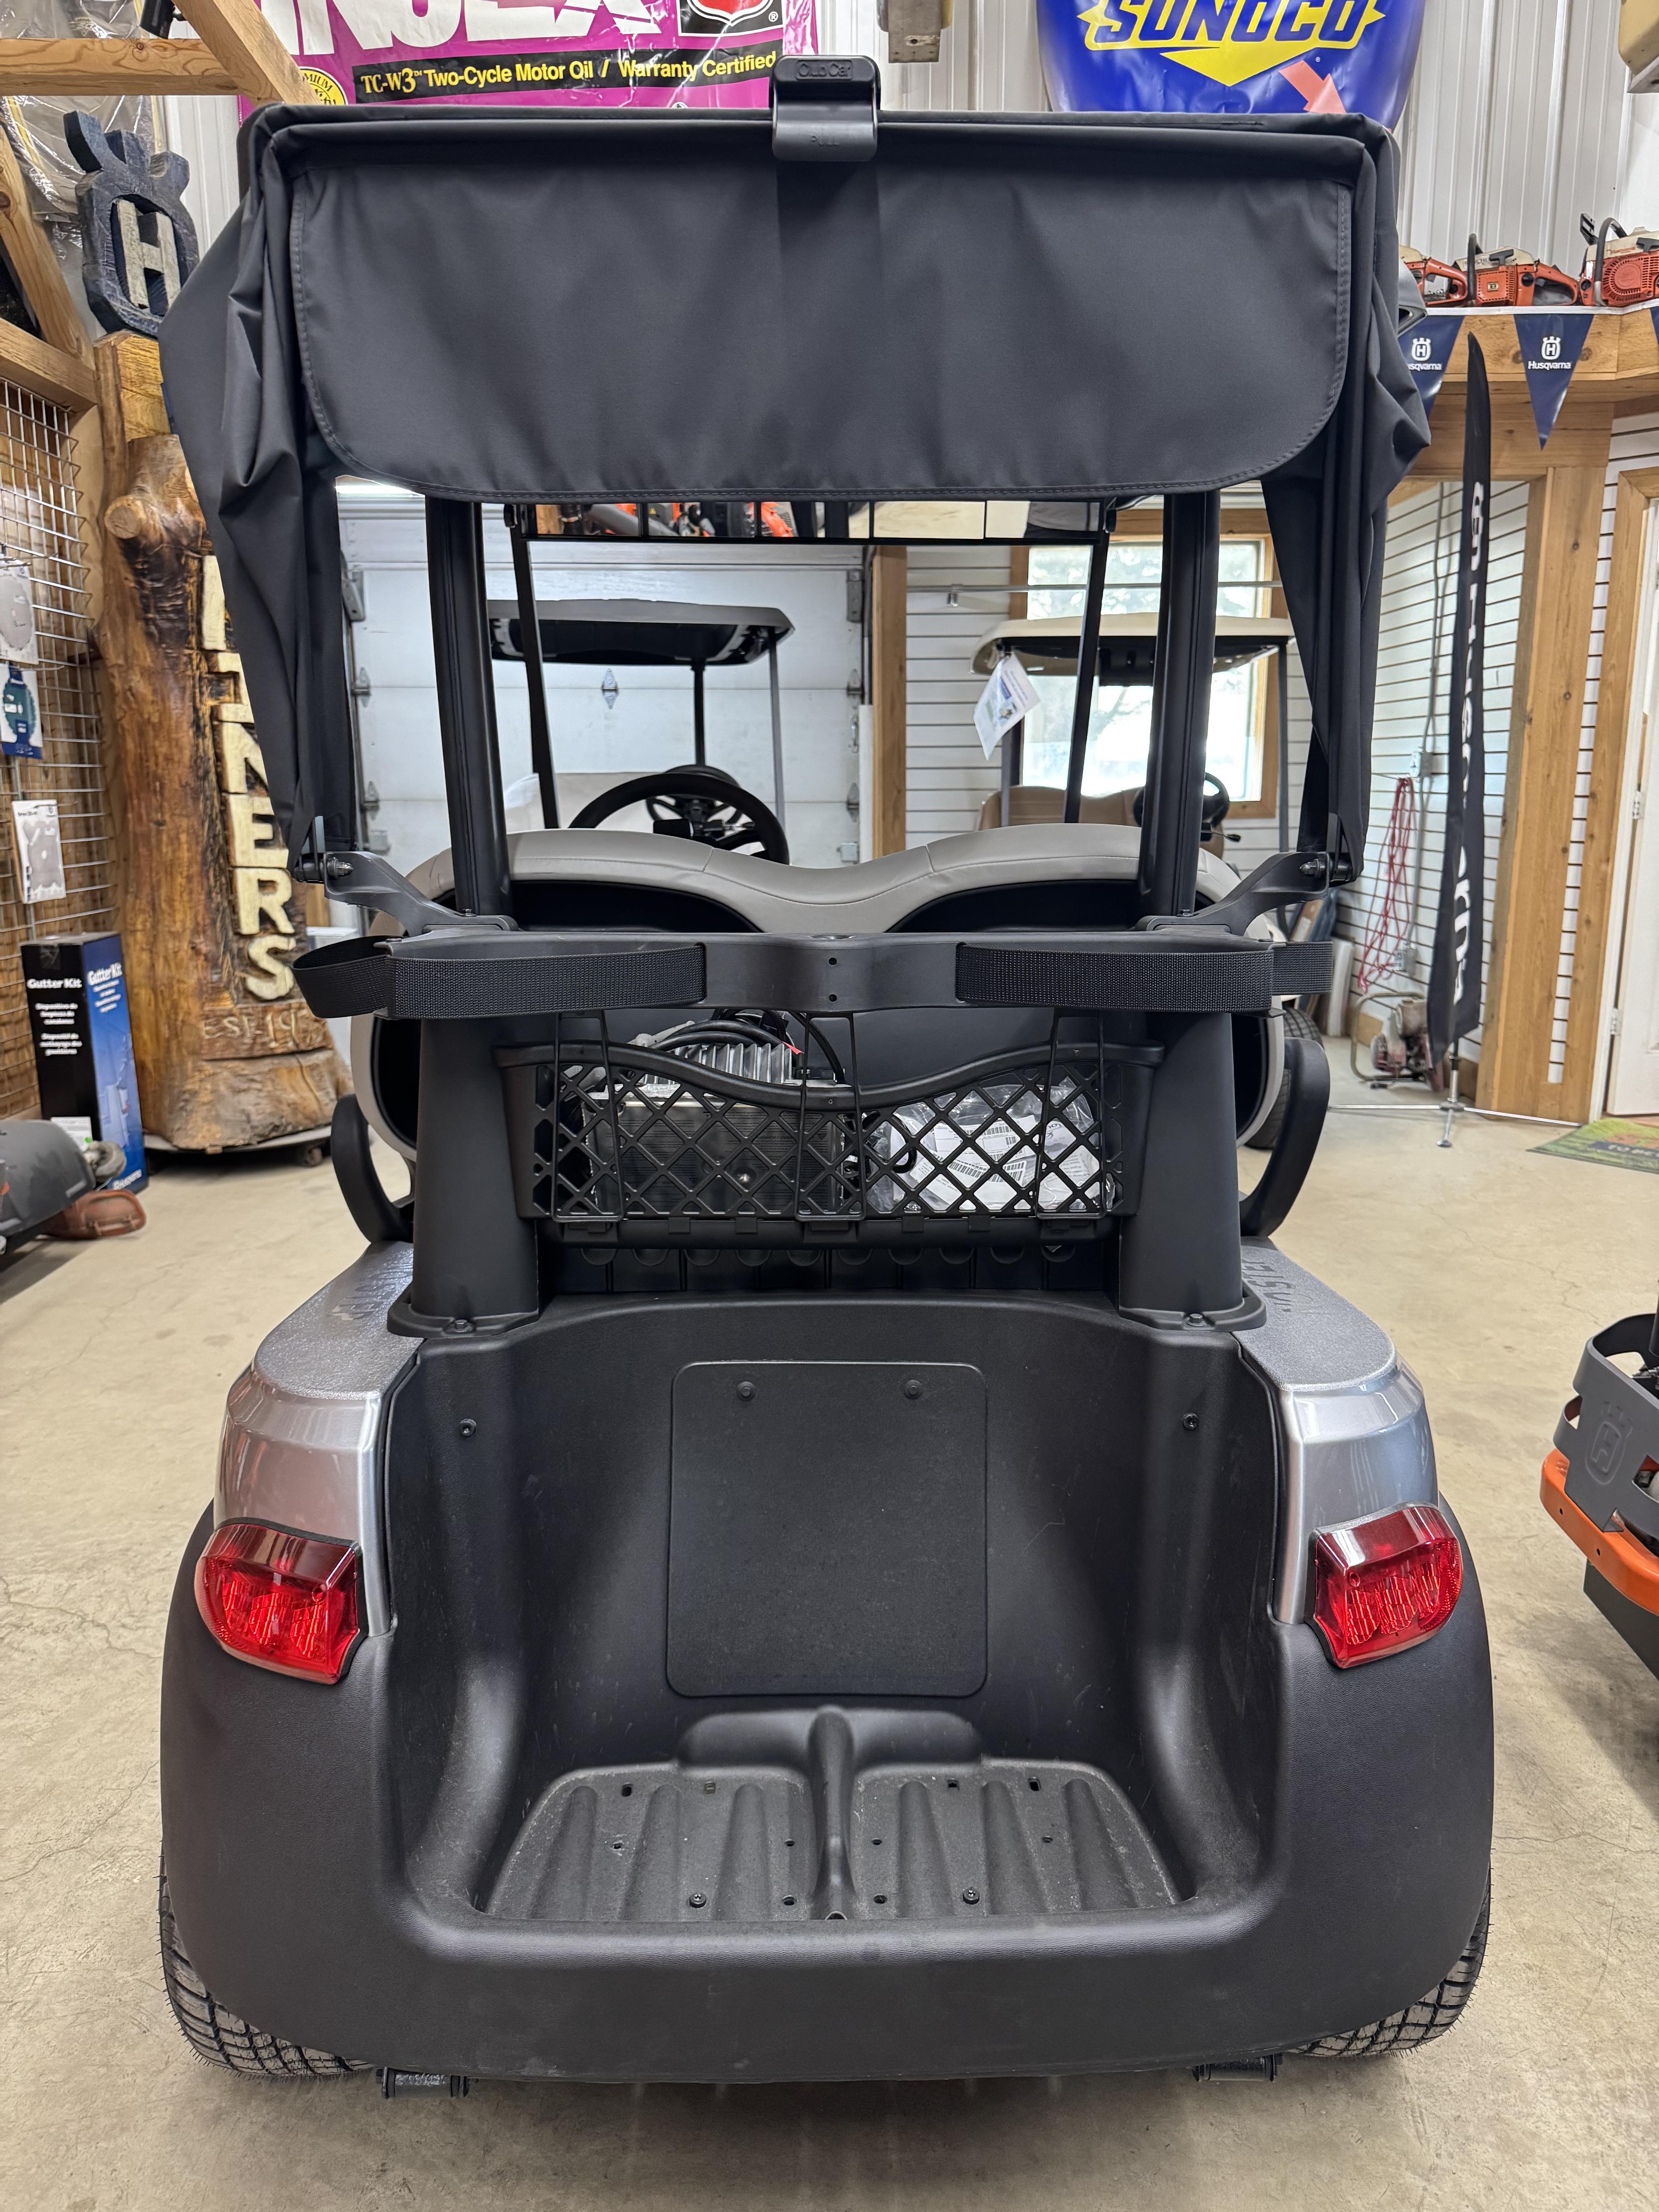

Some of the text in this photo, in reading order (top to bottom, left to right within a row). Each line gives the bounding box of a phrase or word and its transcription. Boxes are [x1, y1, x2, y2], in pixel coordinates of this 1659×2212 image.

[1094, 0, 1376, 42] SUNOCO
[423, 65, 512, 88] Two-Cycle
[515, 63, 565, 81] Motor
[569, 61, 592, 79] Oil
[618, 60, 697, 81] Warranty
[702, 51, 776, 77] Certified
[797, 63, 851, 77] Club Car
[1407, 362, 1442, 371] usqvarna
[1527, 361, 1572, 370] Husqvarna
[87, 962, 123, 986] Gutter Kit
[27, 978, 63, 989] Gutter
[63, 978, 82, 988] Kit
